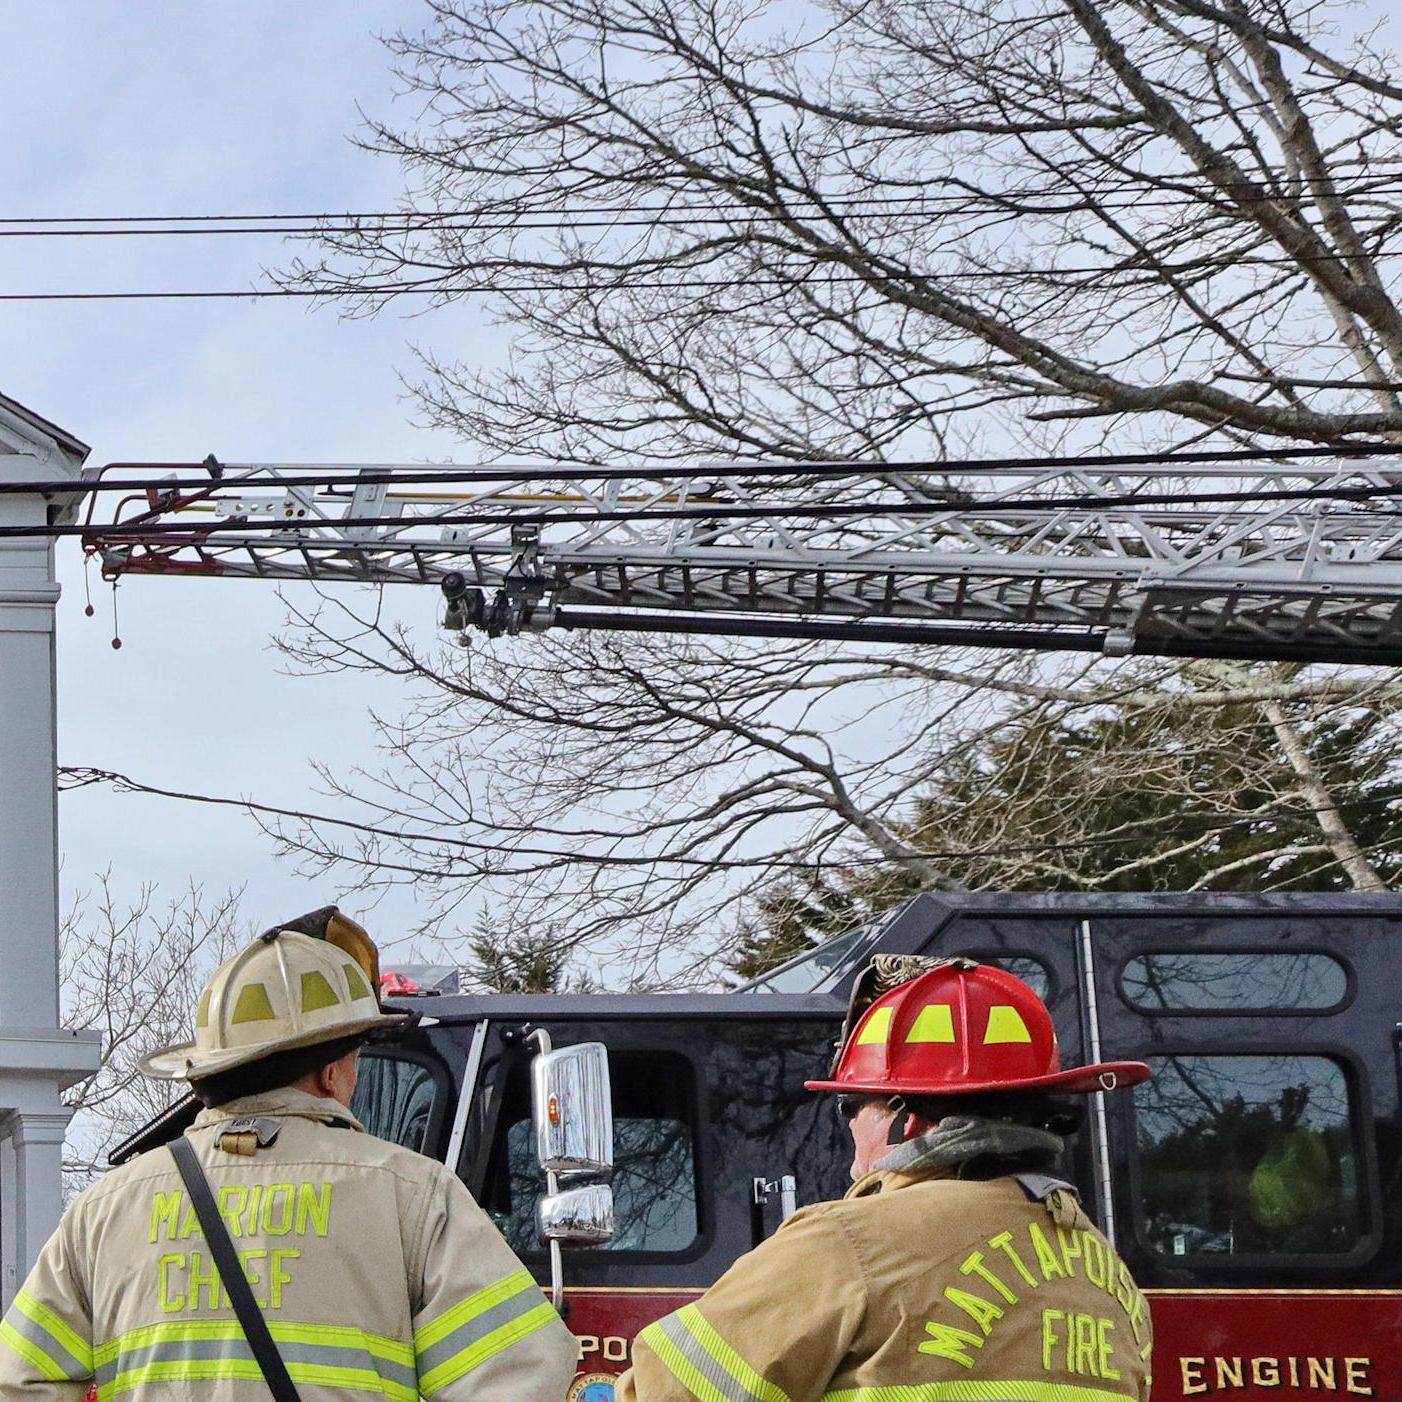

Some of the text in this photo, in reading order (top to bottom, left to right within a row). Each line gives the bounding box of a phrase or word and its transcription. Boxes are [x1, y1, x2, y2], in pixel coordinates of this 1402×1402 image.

[158, 1249, 301, 1313] CHEF
[1042, 1308, 1122, 1380] FIRE
[1179, 1356, 1373, 1395] ENGINE
